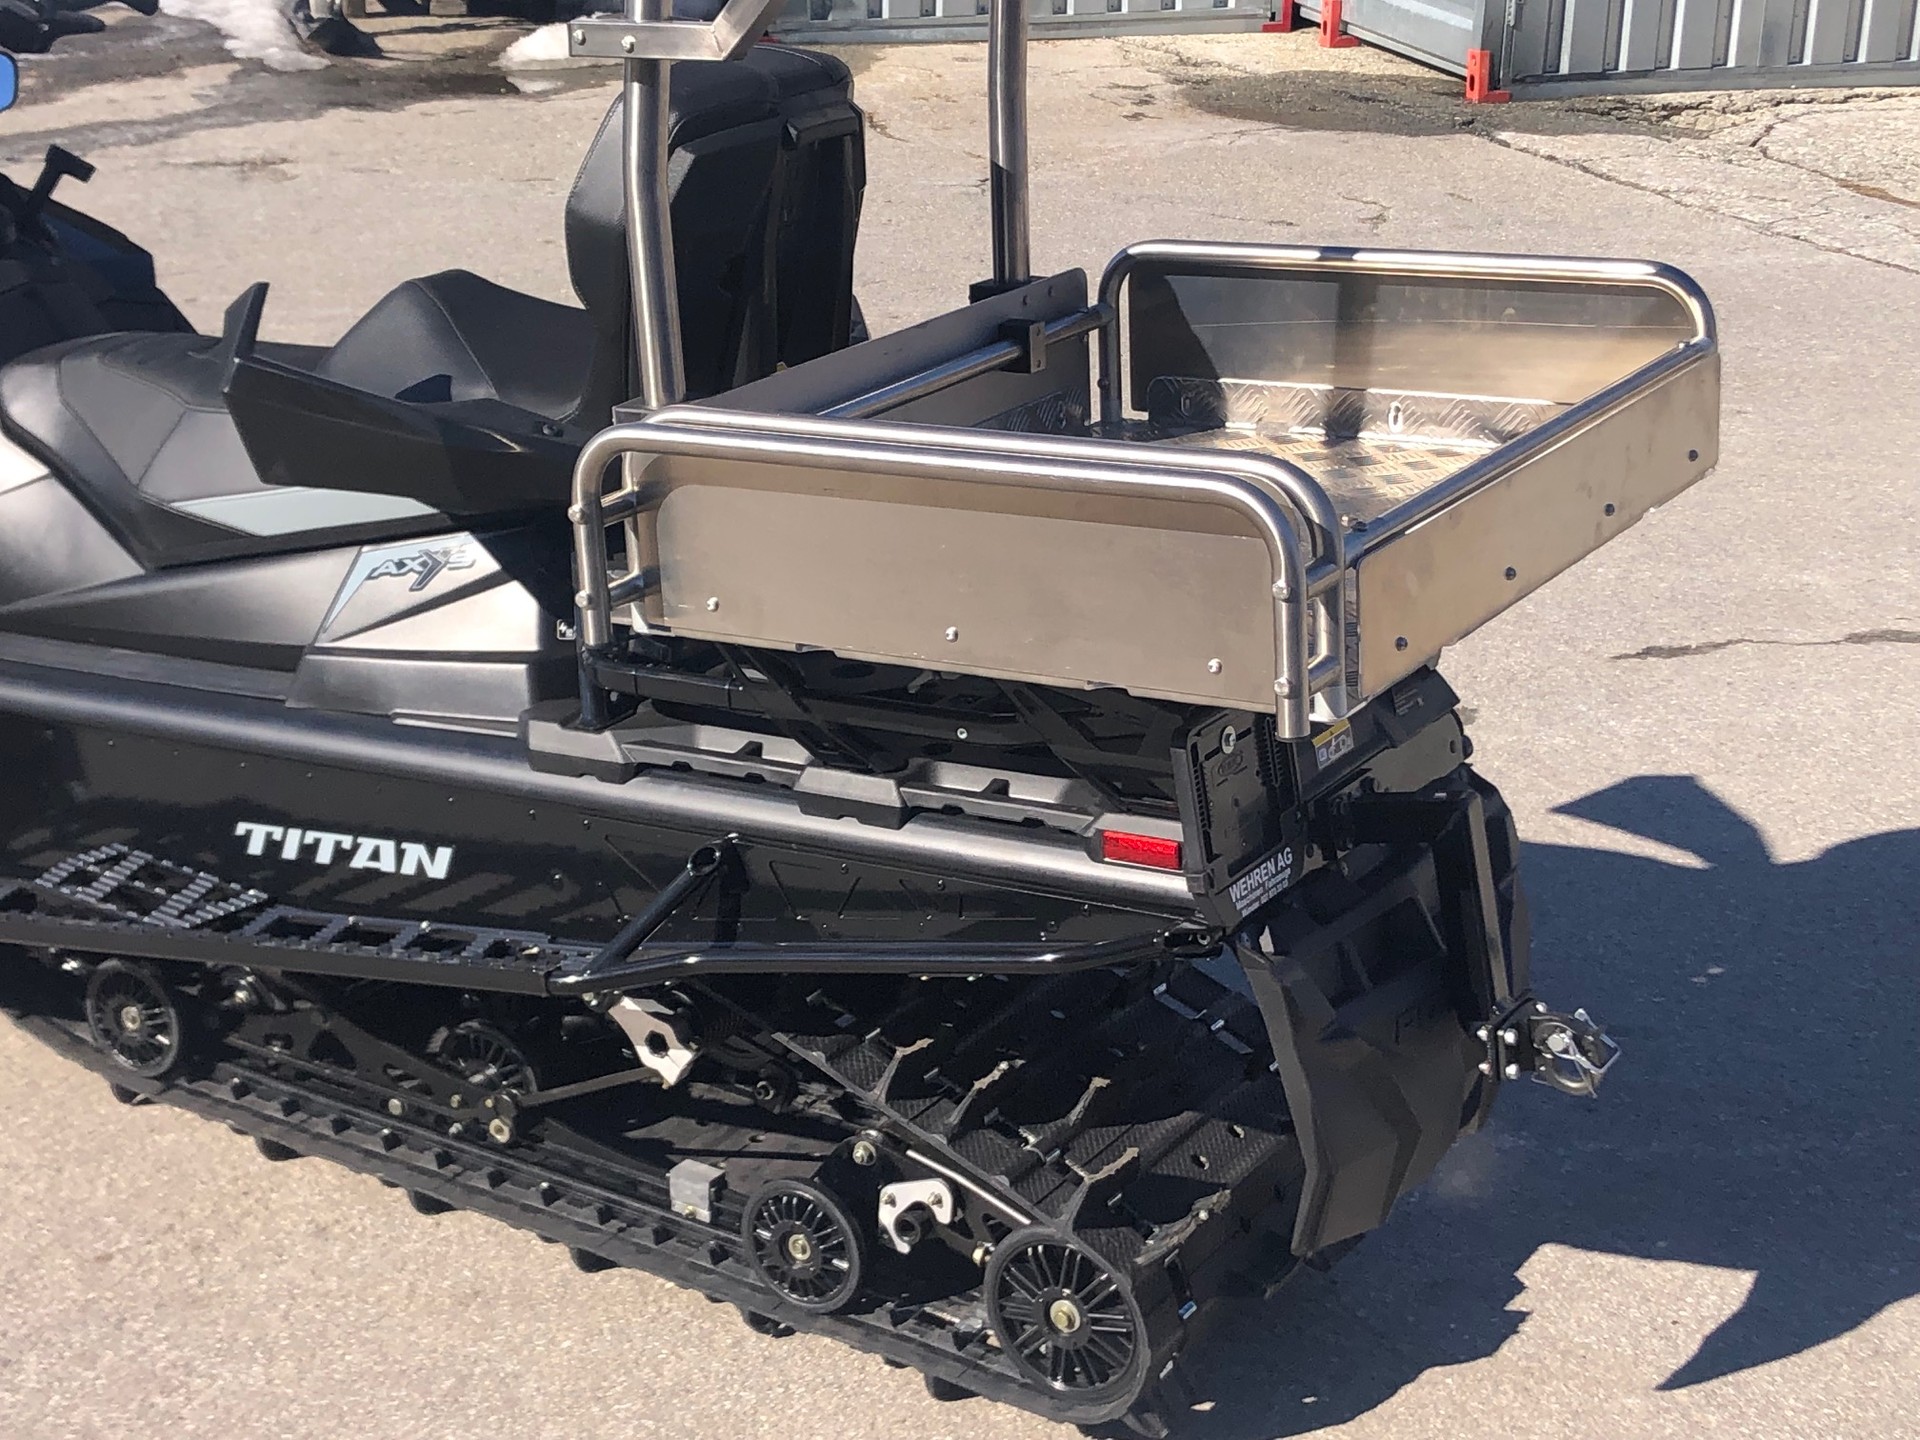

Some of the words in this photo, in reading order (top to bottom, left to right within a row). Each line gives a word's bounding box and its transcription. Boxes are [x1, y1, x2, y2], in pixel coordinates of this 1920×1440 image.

[234, 821, 453, 879] TITAN
[1228, 858, 1276, 903] WEHREN
[1277, 847, 1293, 871] AG
